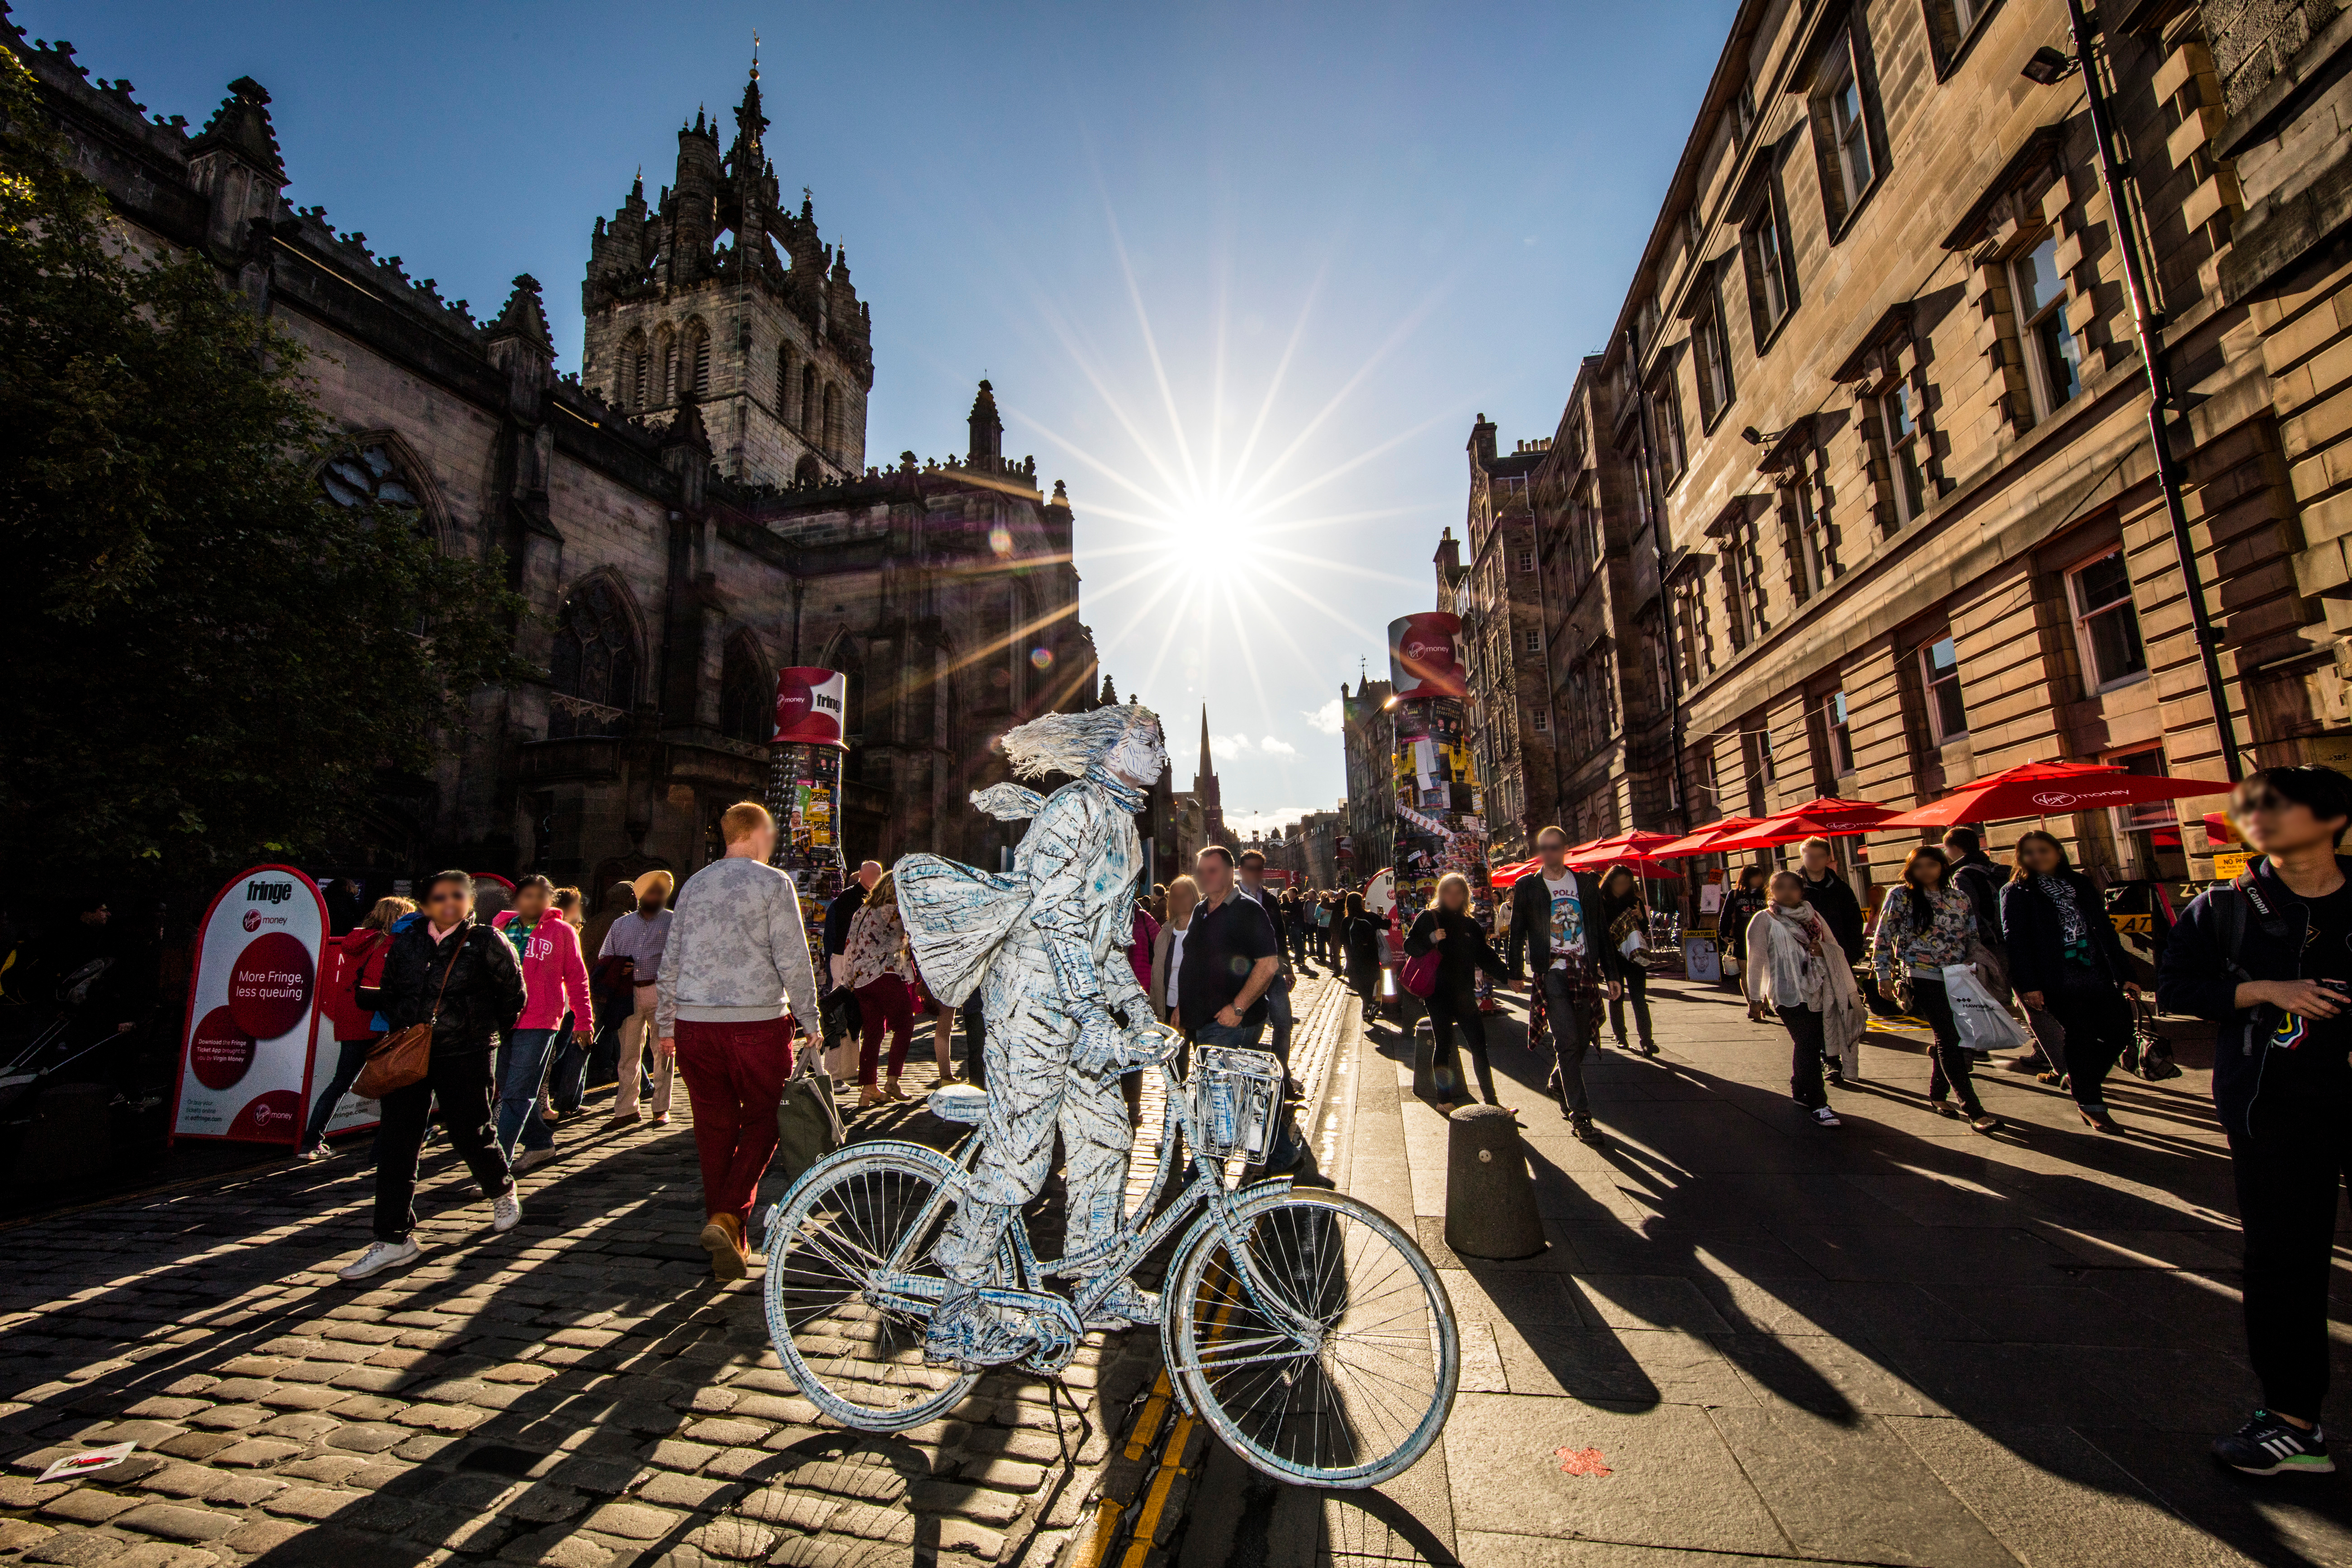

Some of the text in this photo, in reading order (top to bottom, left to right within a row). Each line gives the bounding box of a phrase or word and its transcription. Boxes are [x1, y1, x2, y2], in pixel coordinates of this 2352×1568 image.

[1409, 644, 1423, 658] Virgin
[2039, 789, 2129, 805] Virgin money
[247, 881, 292, 904] fringe
[2246, 886, 2270, 914] Canon
[244, 911, 288, 929] Virgin money
[239, 971, 303, 986] More Fringe,
[236, 985, 303, 1001] less queuing
[256, 1107, 293, 1123] Virgin money
[341, 1103, 355, 1111] your
